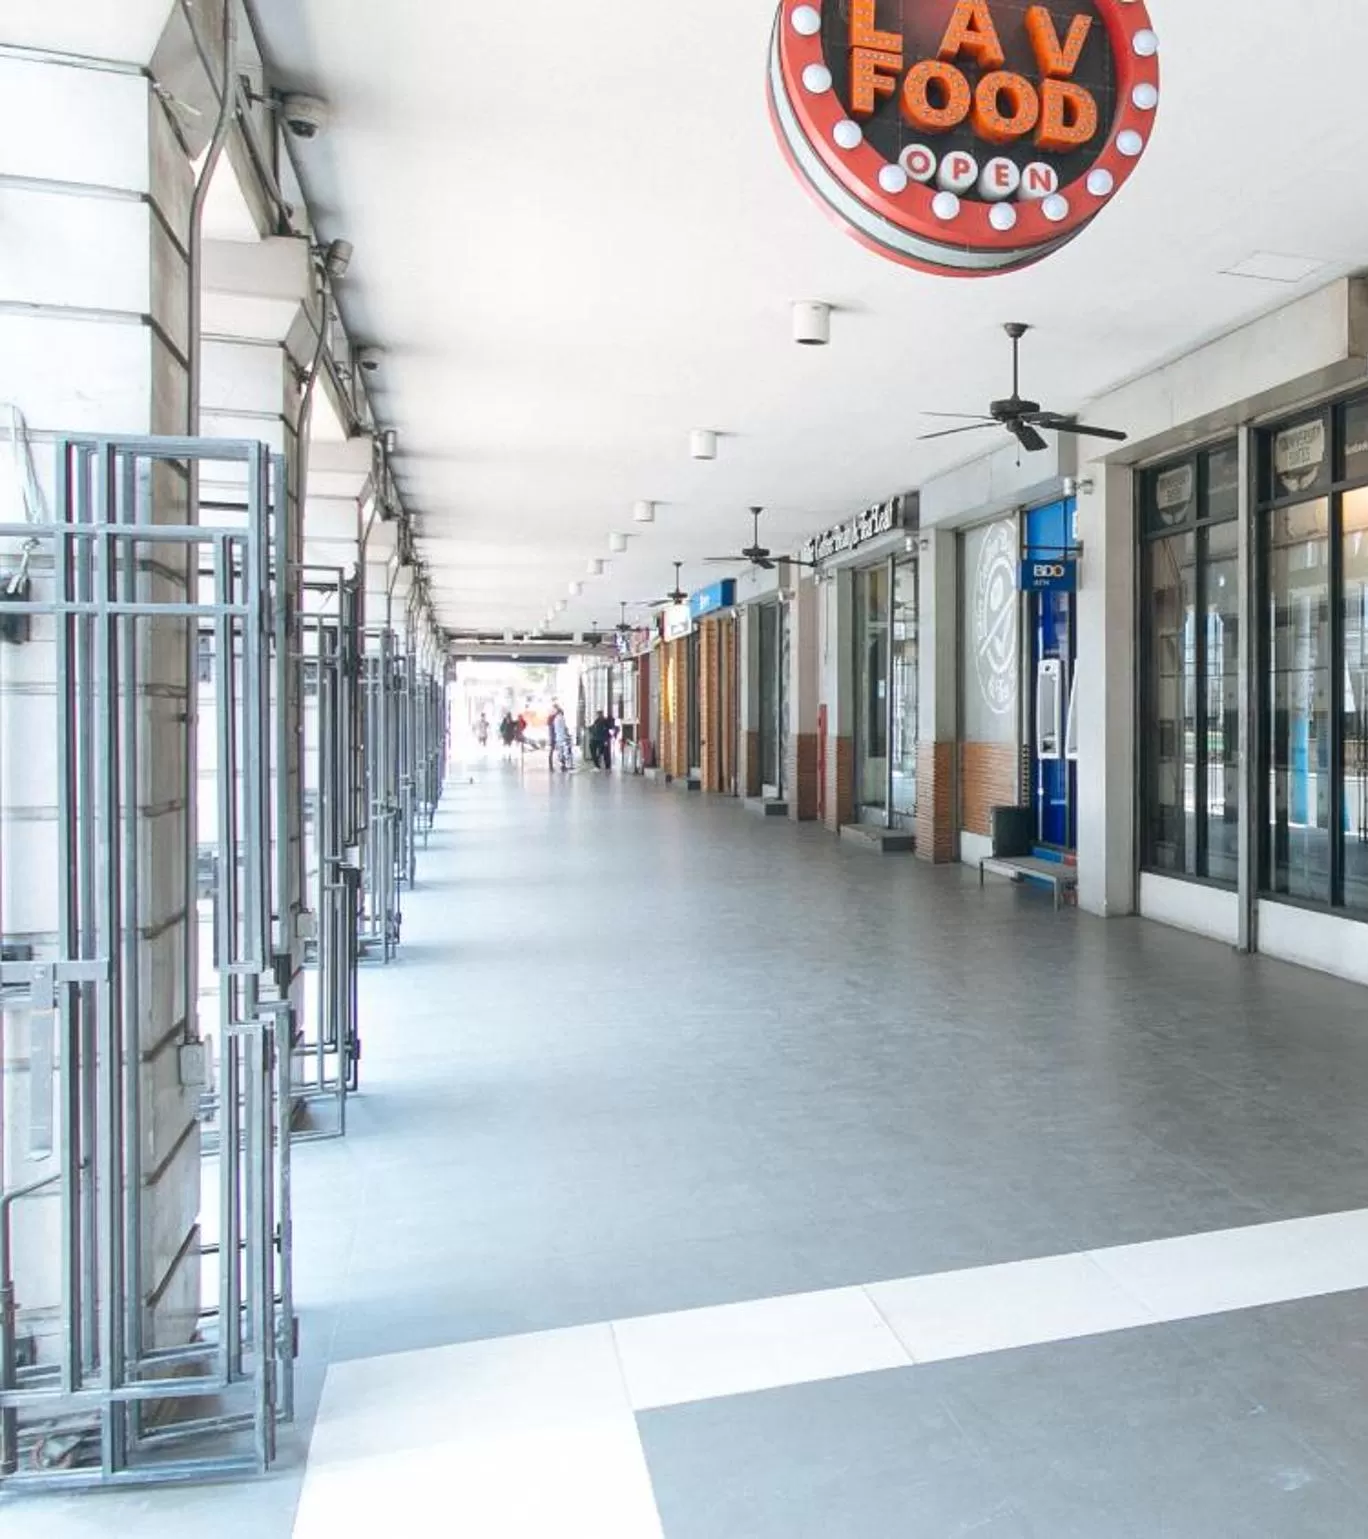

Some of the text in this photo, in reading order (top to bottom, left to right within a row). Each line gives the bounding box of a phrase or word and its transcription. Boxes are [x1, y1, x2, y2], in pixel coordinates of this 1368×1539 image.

[848, 46, 1098, 153] FOOD
[904, 148, 1054, 194] OPEN
[1033, 564, 1065, 578] BDO
